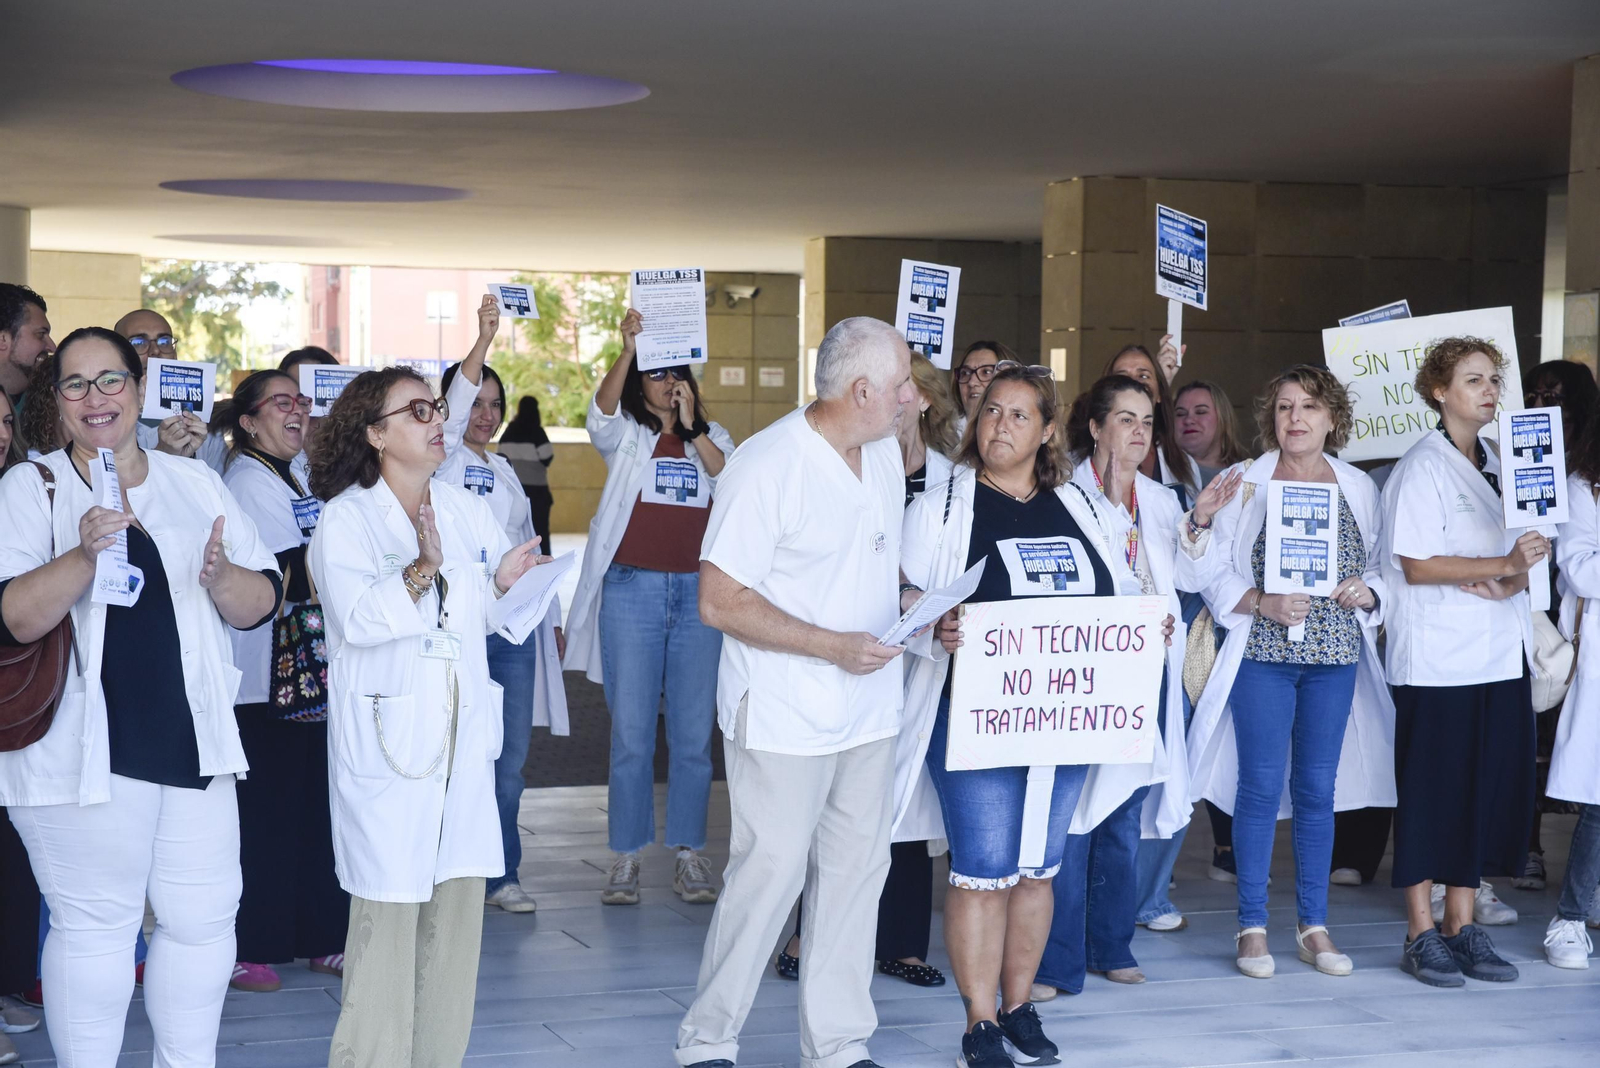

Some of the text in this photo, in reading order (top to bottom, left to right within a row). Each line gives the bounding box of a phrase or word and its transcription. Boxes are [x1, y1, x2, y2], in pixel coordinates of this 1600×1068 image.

[1160, 246, 1204, 276] HUELGA TSS
[639, 270, 698, 279] HUELGA TSS
[912, 283, 946, 299] HUELGA TSS
[907, 330, 941, 346] HUELGA TSS
[1352, 350, 1390, 377] SIN
[167, 375, 184, 383] servicios
[185, 376, 200, 384] mínimos
[162, 385, 202, 401] HUELGA TSS
[1383, 382, 1414, 406] NO
[1514, 432, 1550, 448] HUELGA TSS
[657, 475, 696, 489] HUELGA TSS
[1517, 485, 1554, 501] HUELGA TSS
[1283, 504, 1328, 520] HUELGA TSS
[1024, 559, 1075, 573] HUELGA TSS
[1282, 556, 1326, 571] HUELGA TSS
[985, 618, 1146, 656] SIN TÉCNICOS
[1002, 667, 1094, 695] NO HAY
[970, 700, 1144, 735] TRATAMIENTOS
